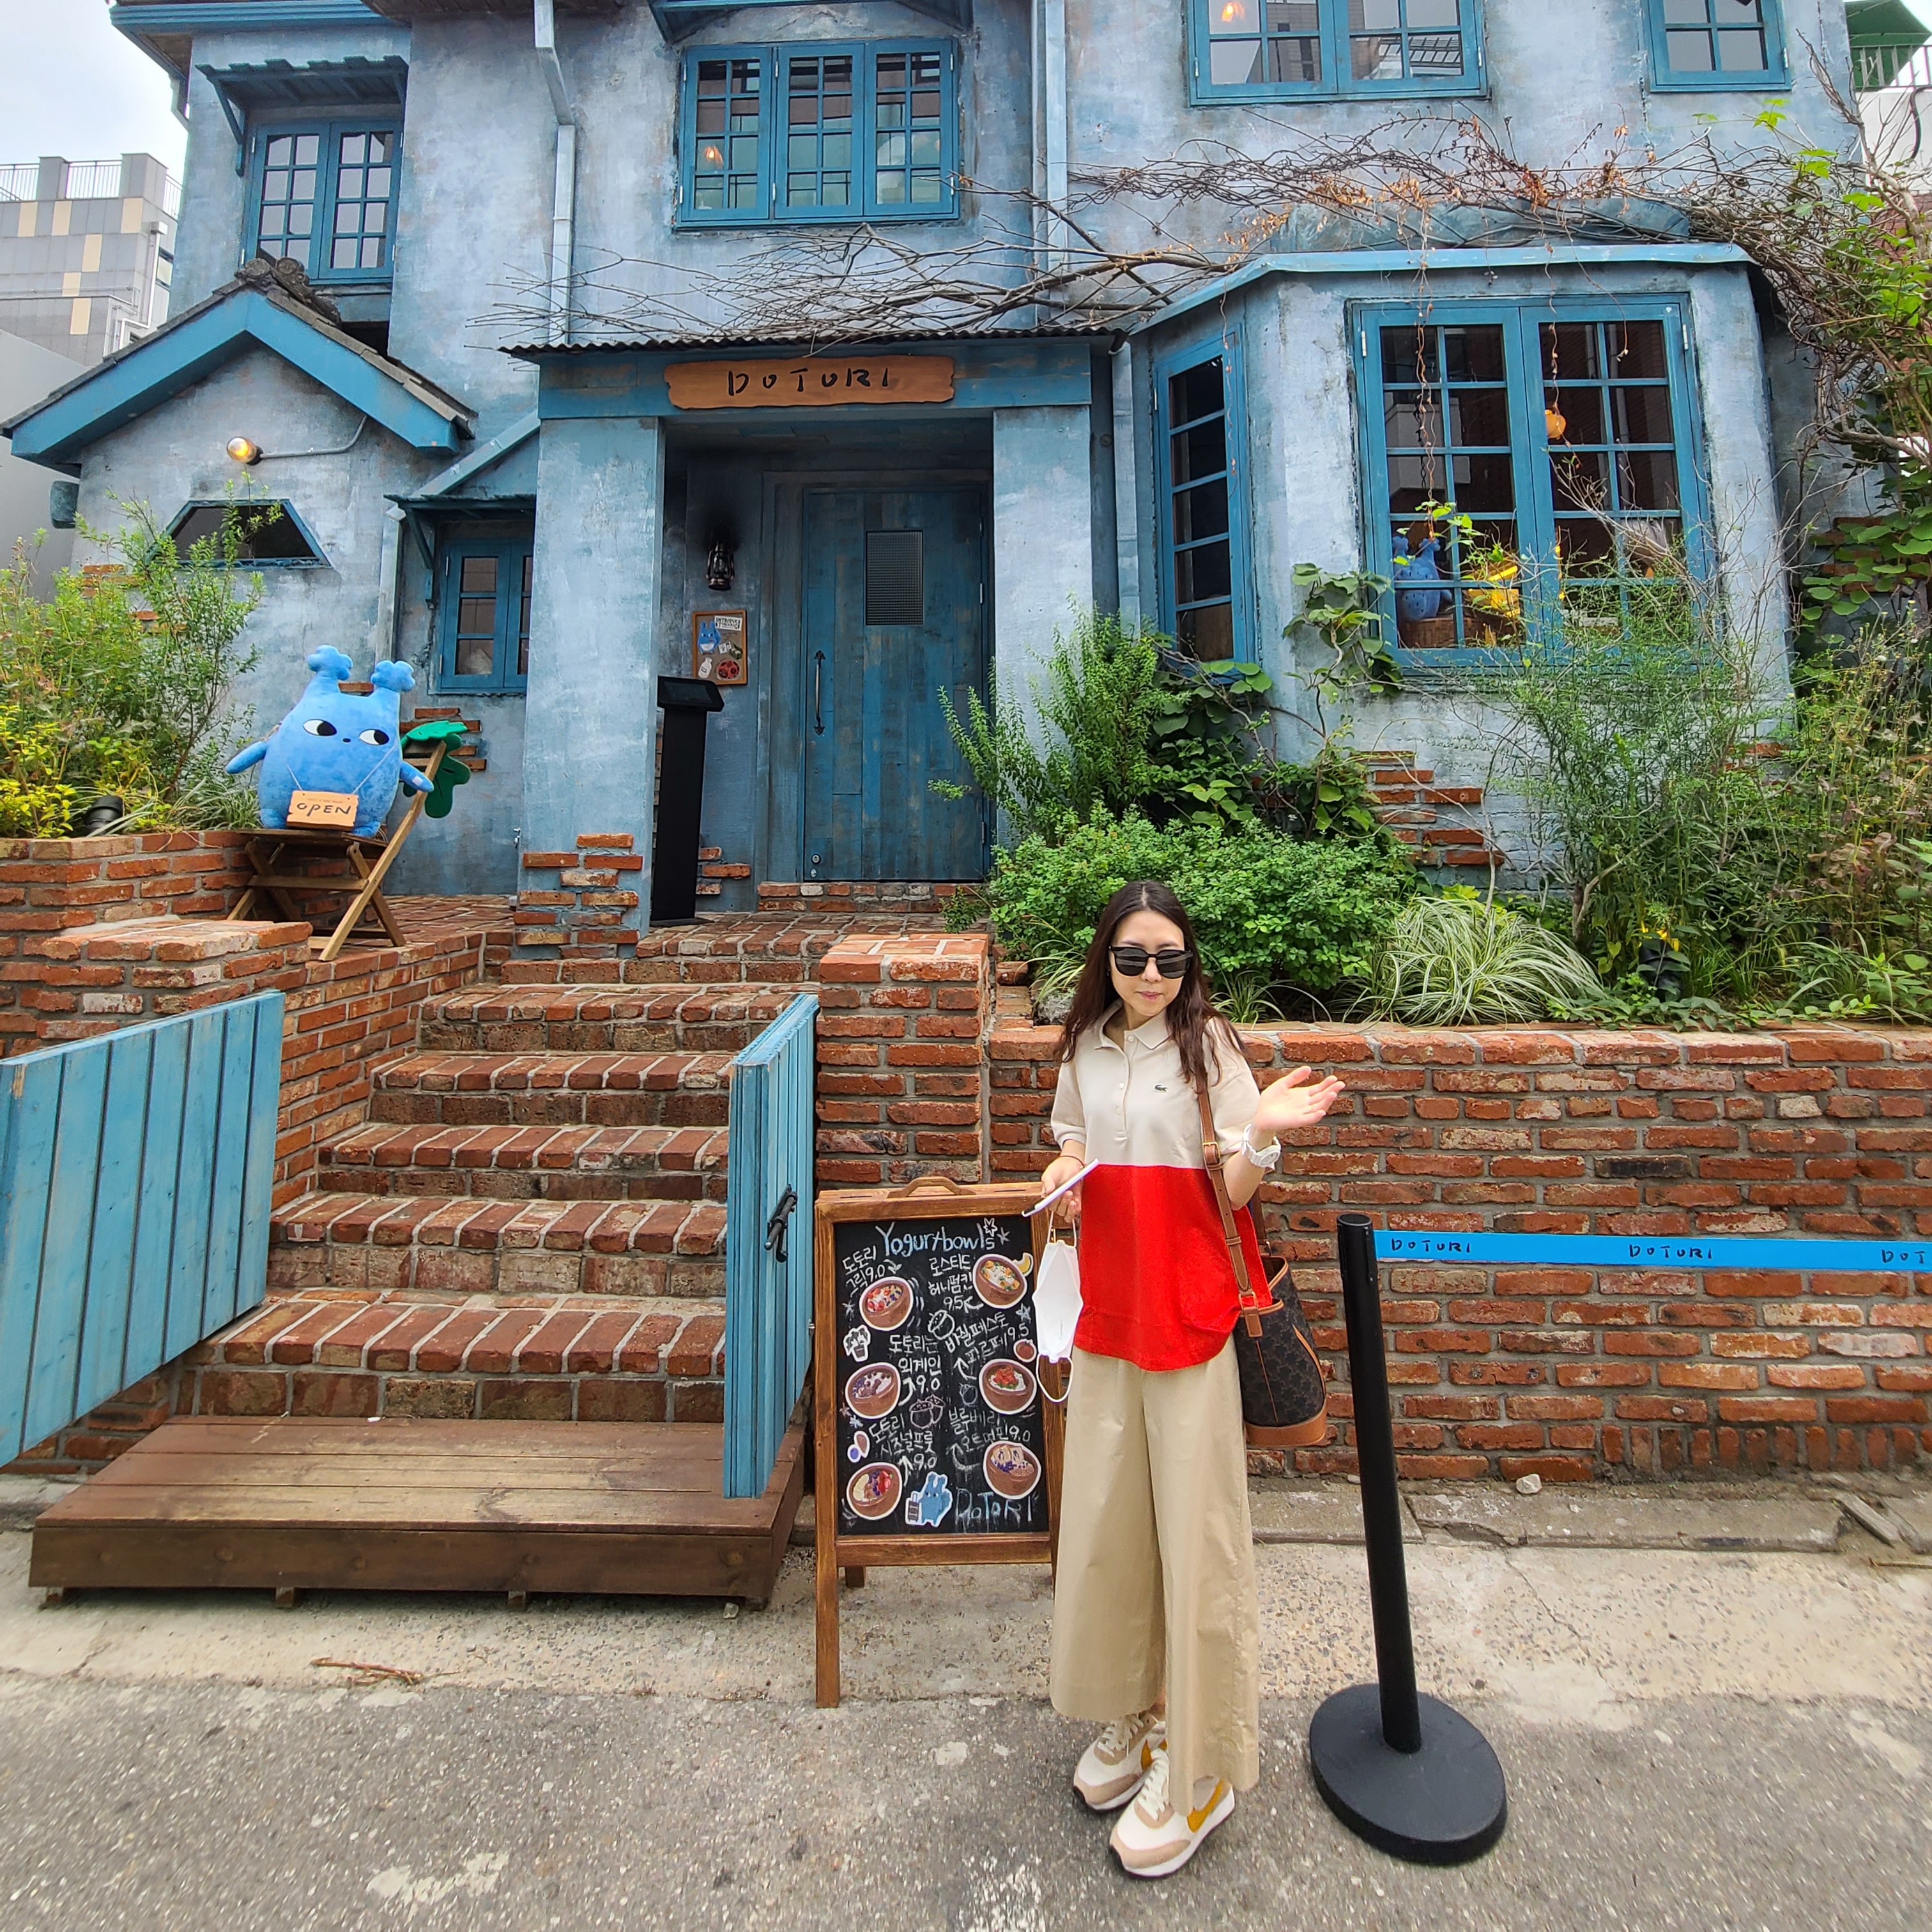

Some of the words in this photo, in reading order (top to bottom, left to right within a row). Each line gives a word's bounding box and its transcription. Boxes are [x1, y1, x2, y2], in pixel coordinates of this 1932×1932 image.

[296, 802, 351, 816] OPEN
[842, 1245, 877, 1275] 도토리
[929, 1253, 971, 1276] 로스티드
[1882, 1248, 1932, 1264] DOT
[928, 1271, 972, 1296] 허니펌킨
[889, 1334, 939, 1354] 도토리는
[945, 1311, 1009, 1353] 바질페스토
[898, 1355, 942, 1376] 외계인
[868, 1413, 905, 1444] 도토리
[948, 1406, 1000, 1435] 블루베리
